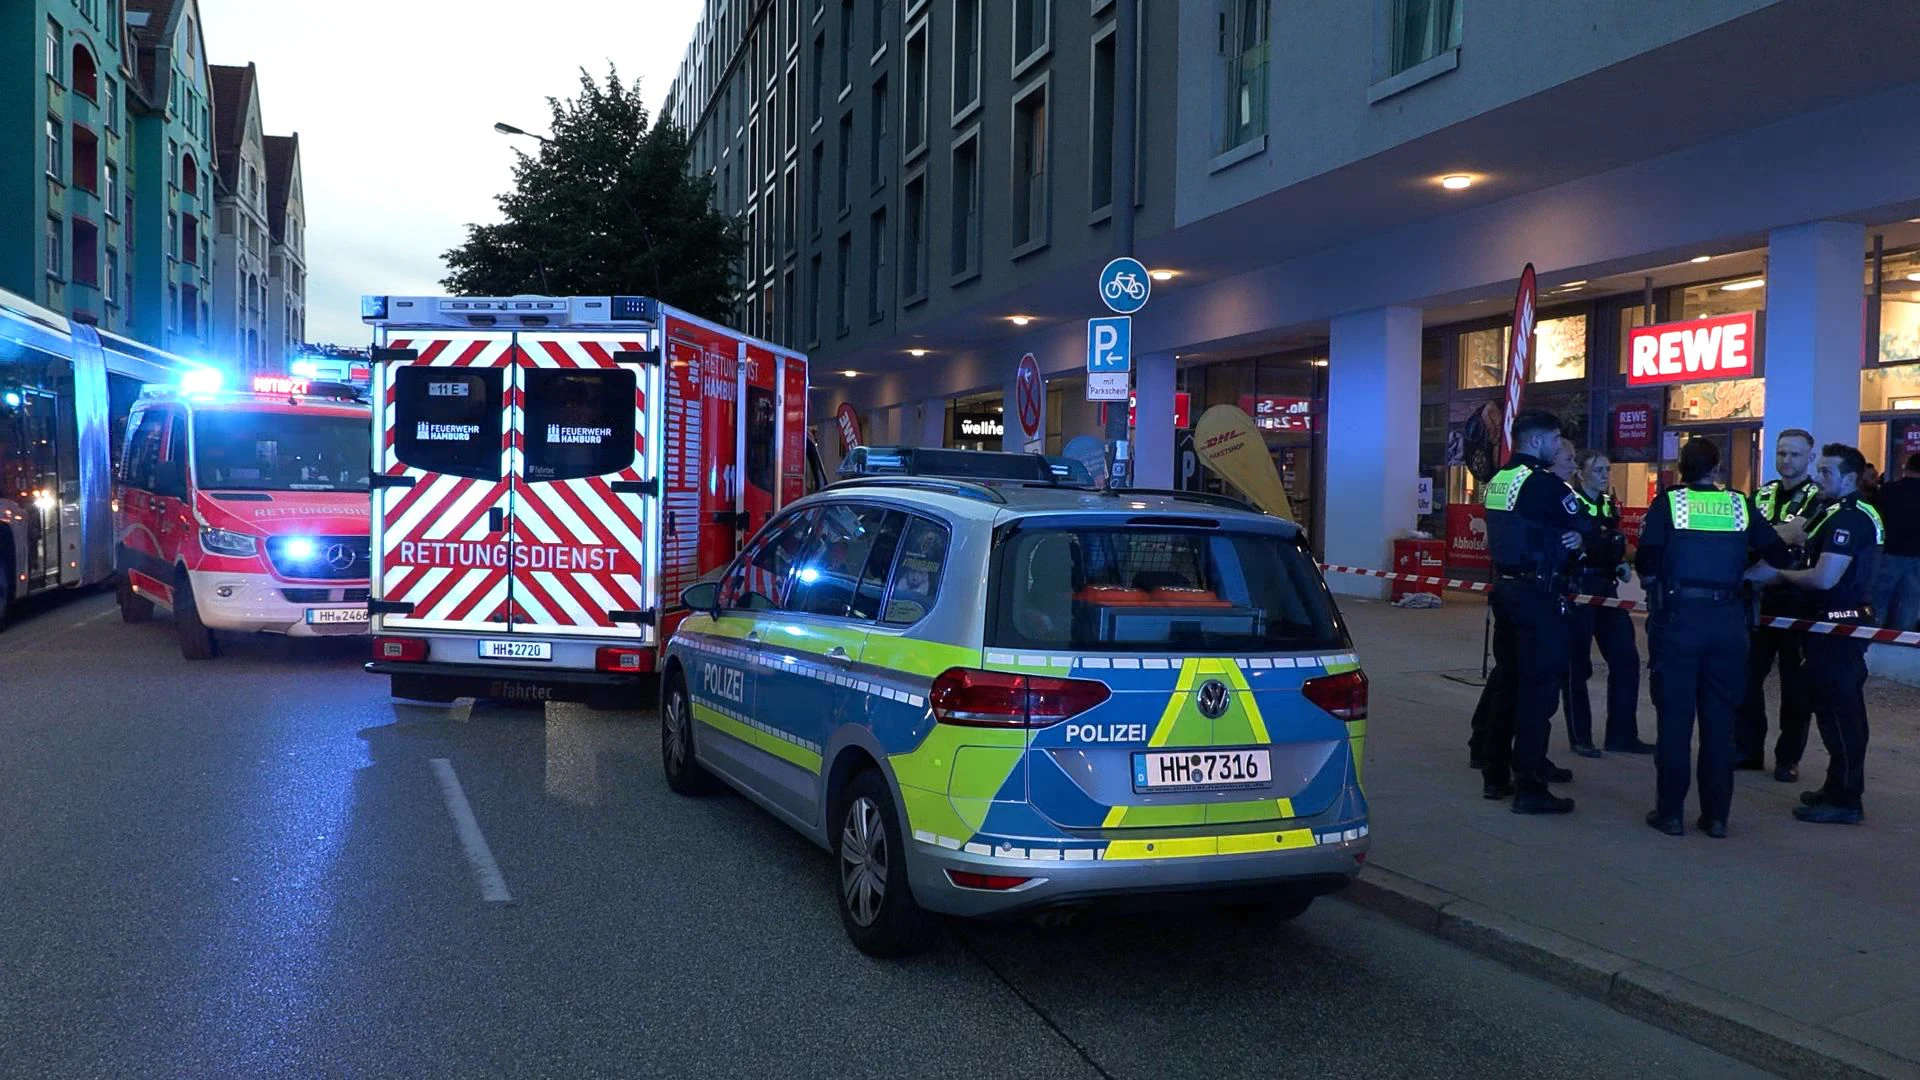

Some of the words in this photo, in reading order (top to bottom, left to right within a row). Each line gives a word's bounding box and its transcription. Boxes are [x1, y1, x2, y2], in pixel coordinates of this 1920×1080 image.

[1095, 325, 1118, 366] P
[1632, 323, 1748, 377] REWE
[1503, 288, 1534, 451] REWE
[1089, 387, 1127, 396] Parkschein
[1619, 410, 1647, 423] REWE
[431, 424, 480, 433] FEUERWEHR
[561, 427, 612, 436] FEUERWEHR
[431, 432, 470, 440] HAMBURG
[561, 435, 602, 444] HAMBURG
[1205, 430, 1240, 448] DHL
[1689, 501, 1734, 516] POLIZEI
[1453, 537, 1486, 551] Abholse
[401, 541, 619, 571] RETTUNGSDIENST
[319, 611, 335, 622] HH
[493, 643, 507, 655] HH
[514, 644, 541, 656] 2720
[704, 662, 744, 703] POLIZEI
[1066, 724, 1147, 742] POLIZEI
[1160, 756, 1191, 782] HH
[1204, 754, 1258, 780] 7316
